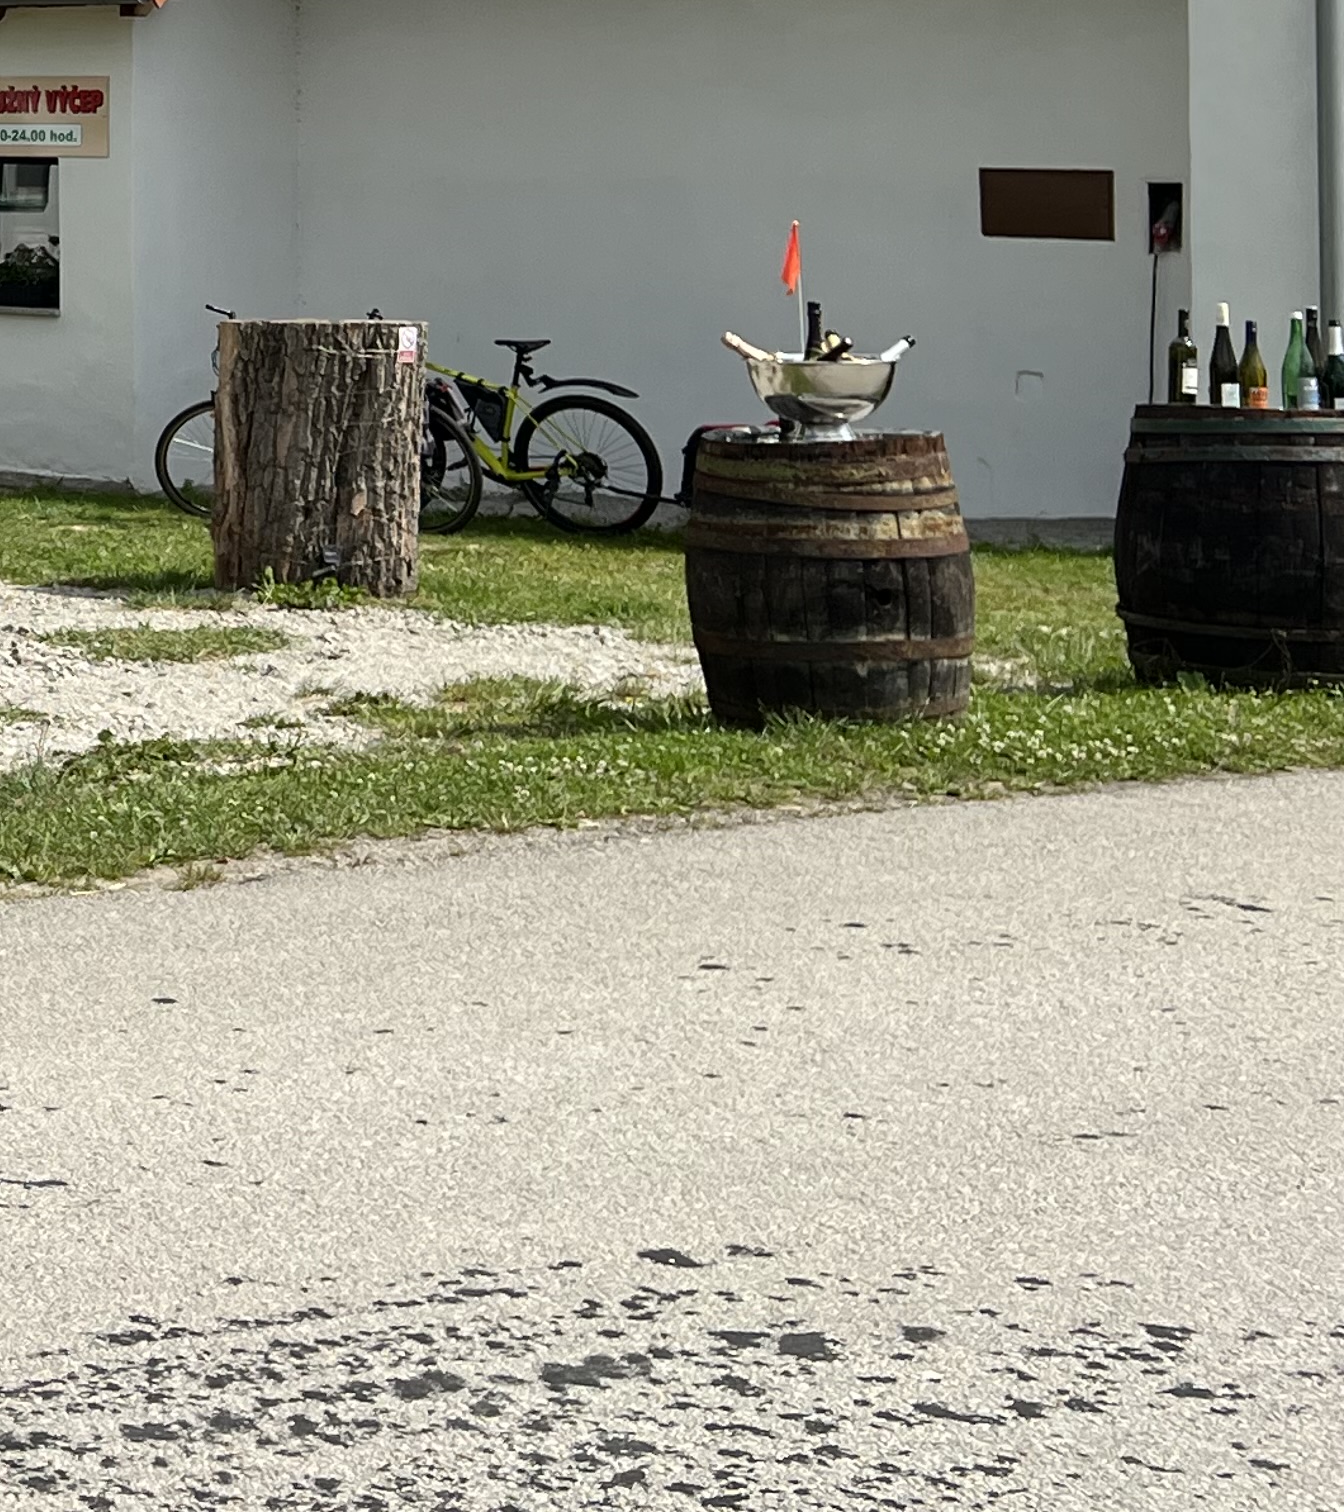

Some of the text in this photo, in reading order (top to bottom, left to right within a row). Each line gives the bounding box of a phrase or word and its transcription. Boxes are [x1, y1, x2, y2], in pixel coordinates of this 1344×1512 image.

[45, 84, 104, 114] VÝČEP
[0, 129, 46, 142] 0-24.00
[49, 129, 77, 142] hod.
